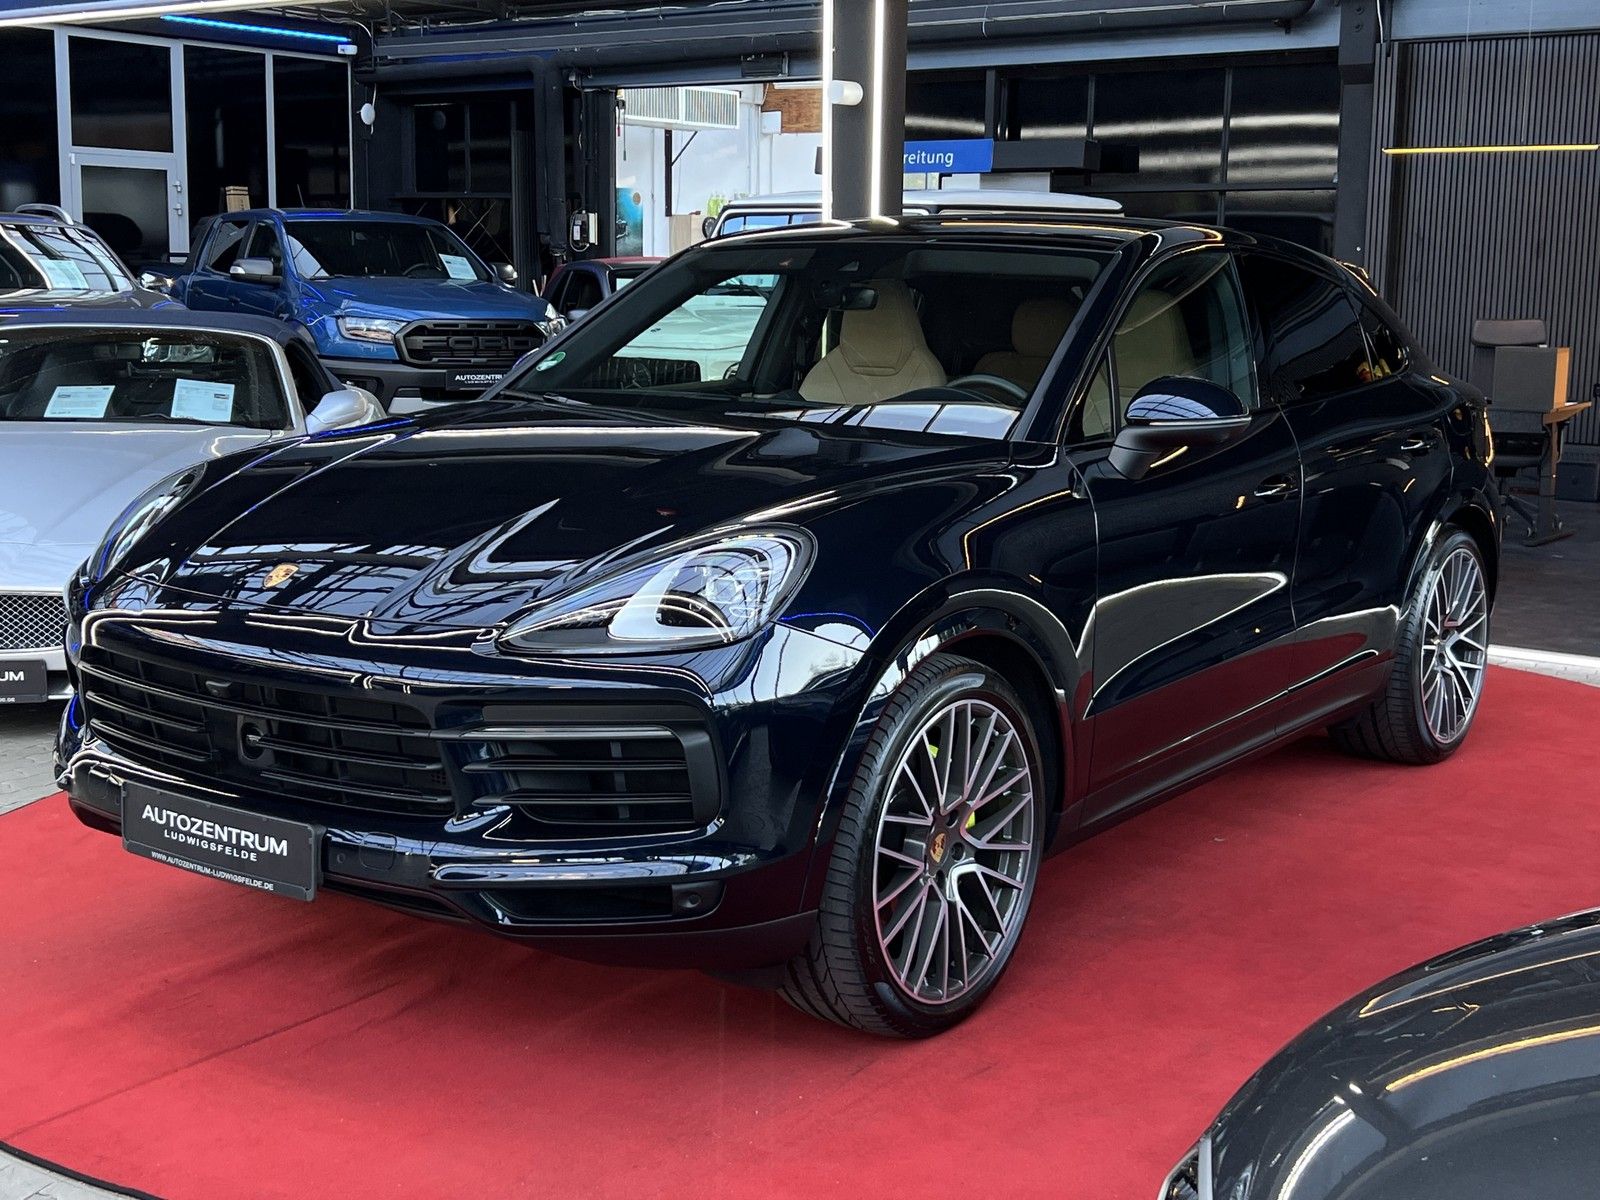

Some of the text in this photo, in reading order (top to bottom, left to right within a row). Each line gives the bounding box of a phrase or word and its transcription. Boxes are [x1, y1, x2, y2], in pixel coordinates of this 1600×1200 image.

[903, 150, 954, 168] reitung
[141, 804, 288, 857] AUTOZENTRUM
[164, 829, 258, 862] LUDWIGSFELDE
[151, 851, 274, 891] WWW.AUTOZENTRUM-LUDWIGSFELDE.DE
